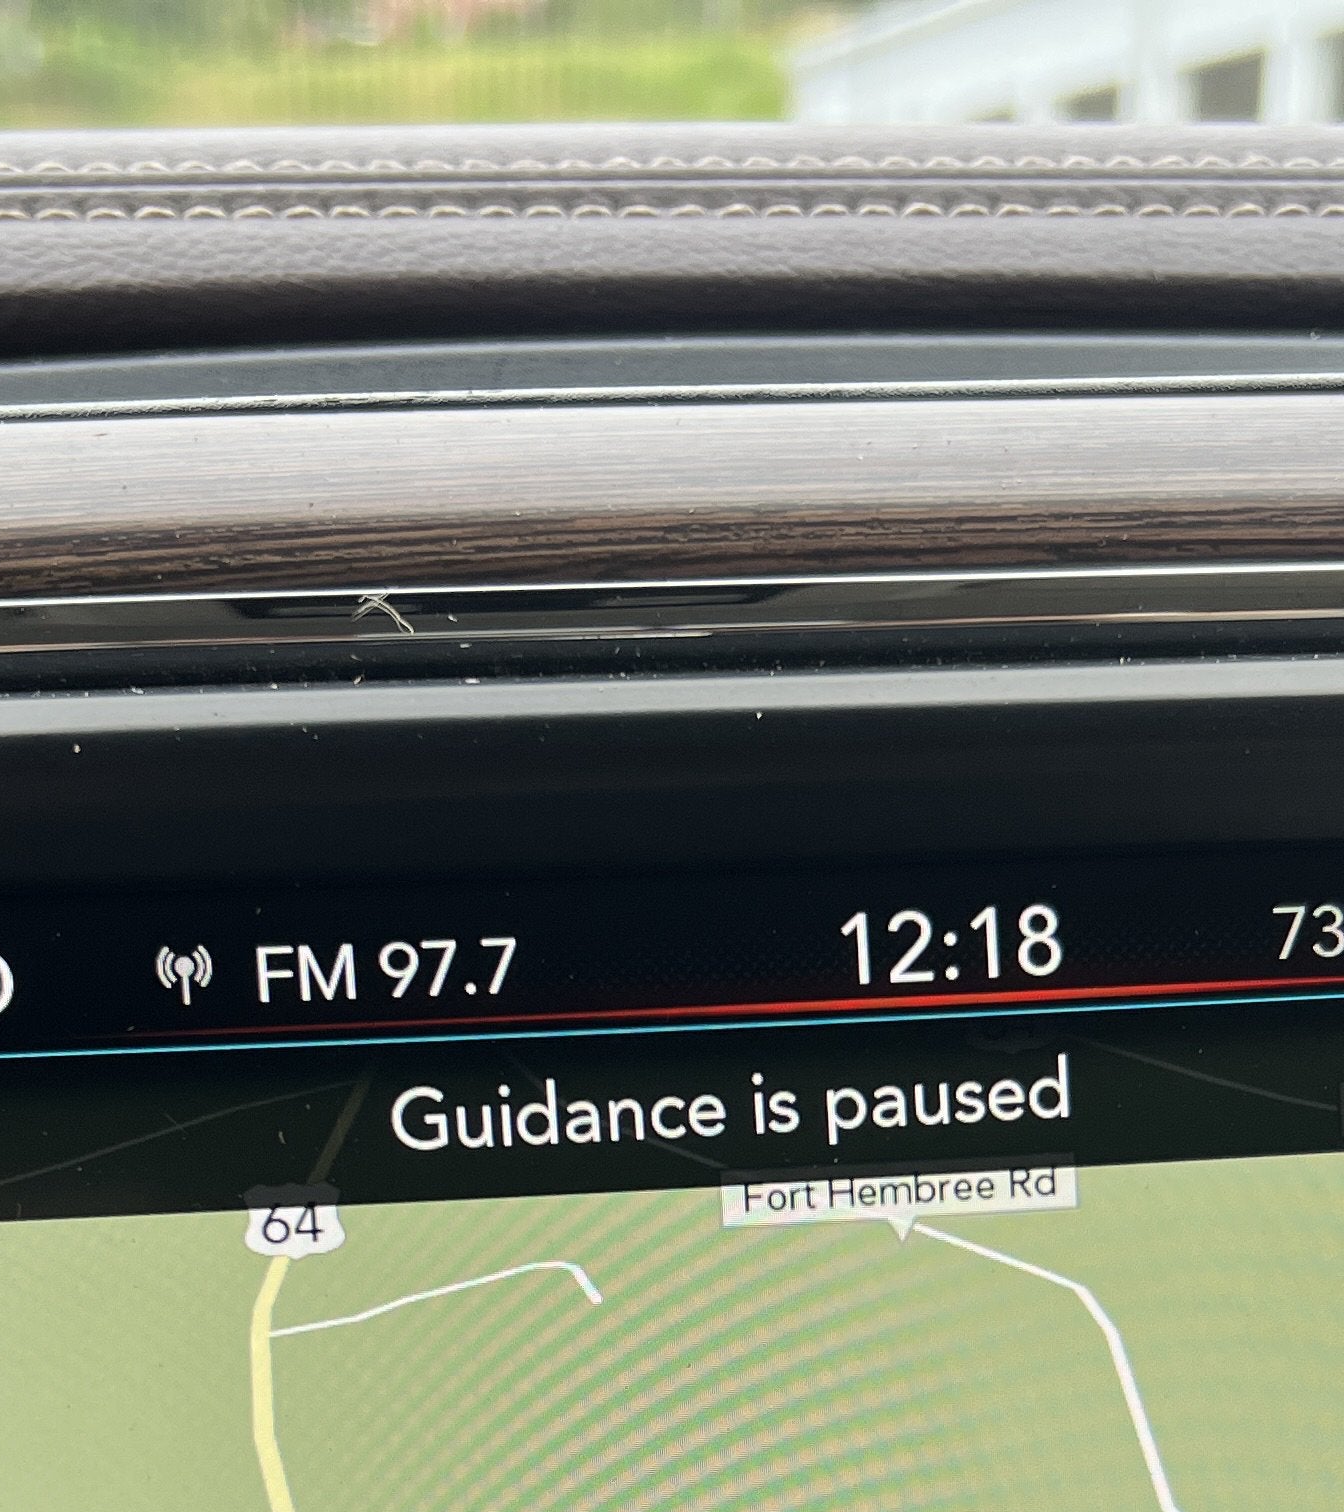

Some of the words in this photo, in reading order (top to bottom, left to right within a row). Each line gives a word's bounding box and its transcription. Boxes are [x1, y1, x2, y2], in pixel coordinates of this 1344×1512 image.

[255, 943, 357, 1003] FM
[378, 937, 517, 998] 97.7
[840, 904, 1063, 985] 12:18
[391, 1078, 727, 1151] Guidance
[751, 1072, 800, 1135] is
[826, 1053, 1070, 1146] paused
[742, 1175, 816, 1216] Fort
[826, 1168, 996, 1210] Hembree
[1006, 1163, 1058, 1200] Rd
[262, 1201, 322, 1245] 64
